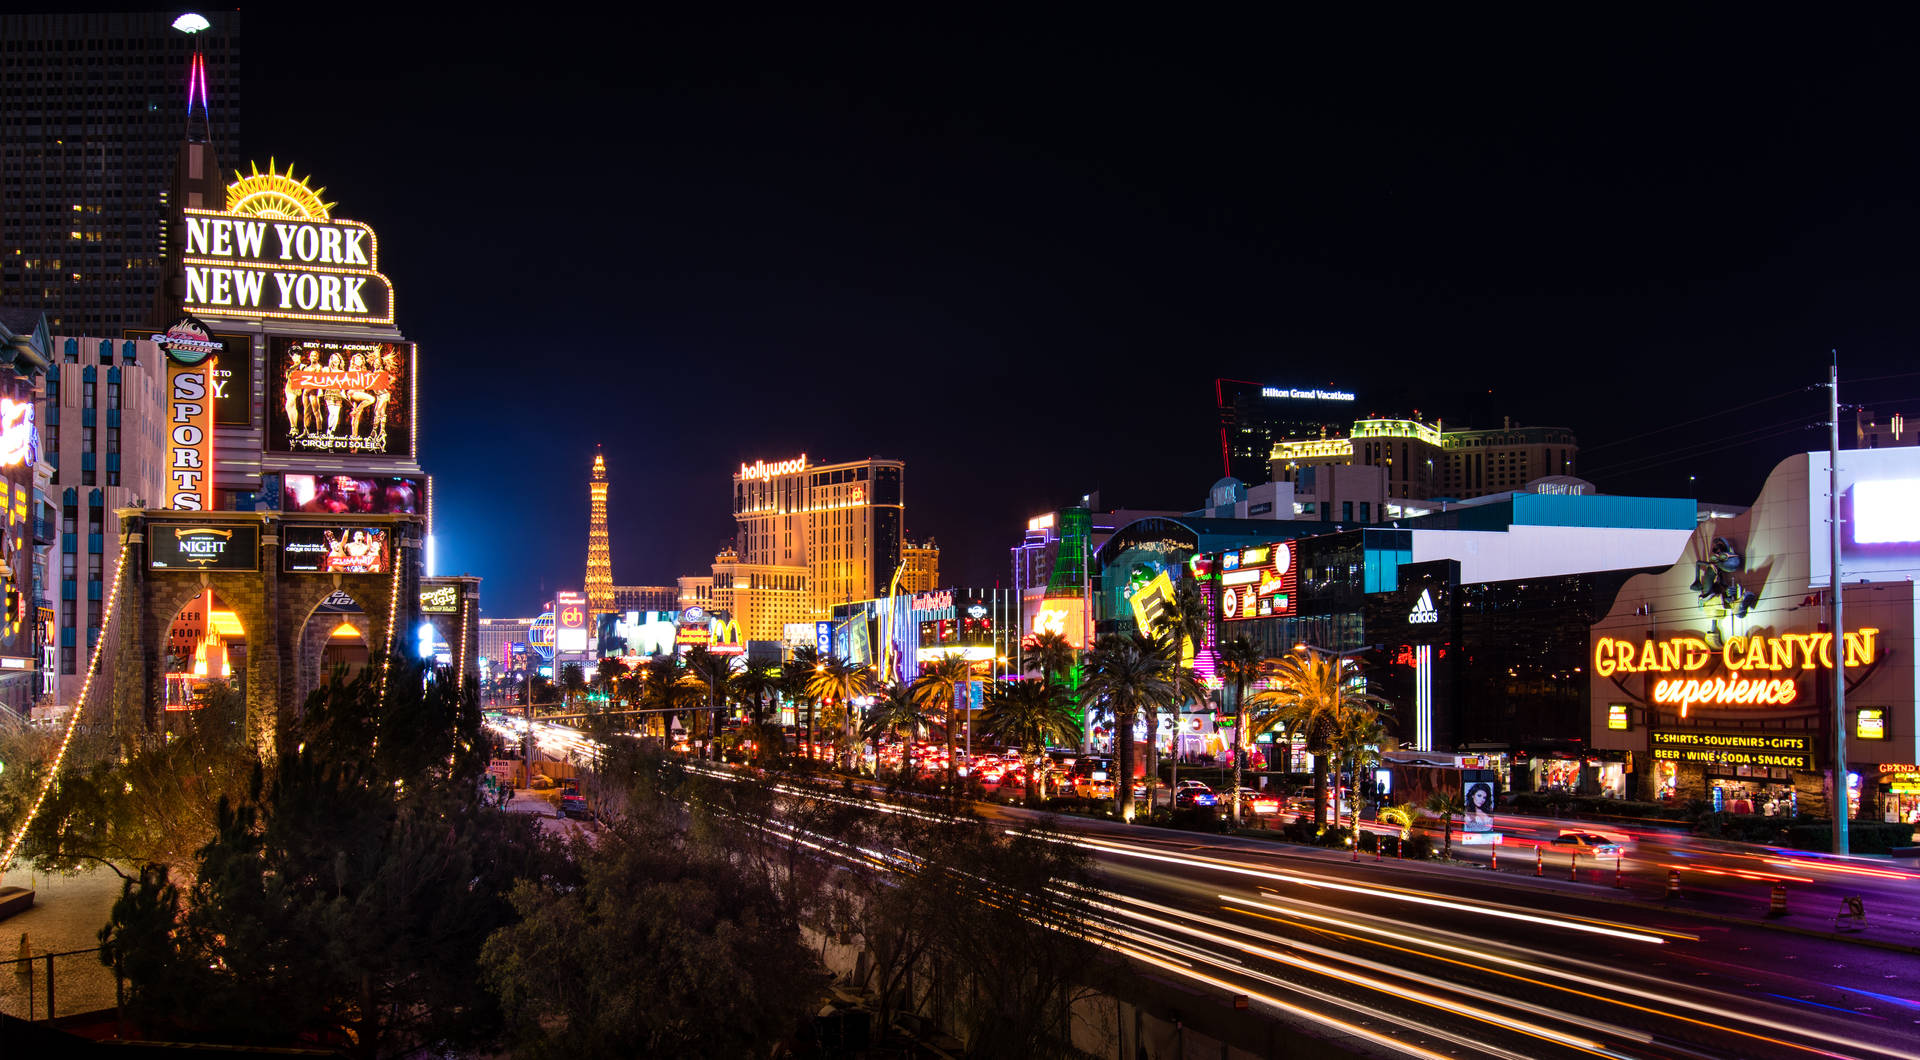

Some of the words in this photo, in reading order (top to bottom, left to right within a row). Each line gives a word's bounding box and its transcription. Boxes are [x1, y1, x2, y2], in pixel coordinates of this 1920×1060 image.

[185, 217, 266, 258] NEW
[274, 223, 368, 265] YORK
[184, 266, 266, 307] NEW
[274, 272, 368, 313] YORK
[300, 372, 381, 389] ZUMANITY
[1262, 388, 1289, 397] Hilton
[1290, 389, 1315, 399] Grand
[1316, 390, 1355, 400] Vacations
[173, 373, 205, 510] SPORTS
[302, 440, 333, 449] CIRQUE
[350, 441, 379, 449] SOLEIL
[741, 453, 806, 482] hollywood
[179, 541, 226, 553] NIGHT
[563, 607, 583, 625] ph
[1409, 611, 1438, 624] adidas
[1595, 637, 1711, 677] GRAND
[1654, 672, 1797, 718] experience
[1654, 733, 1698, 744] T-SHIRTS
[1704, 735, 1764, 747] SOUVENIRS
[1771, 738, 1804, 749] GIFTS
[1655, 750, 1680, 759] BEER
[1686, 751, 1715, 761] WINE
[1721, 753, 1751, 763] SODA
[1757, 754, 1804, 767] SNACKS
[1879, 764, 1915, 773] GRAND
